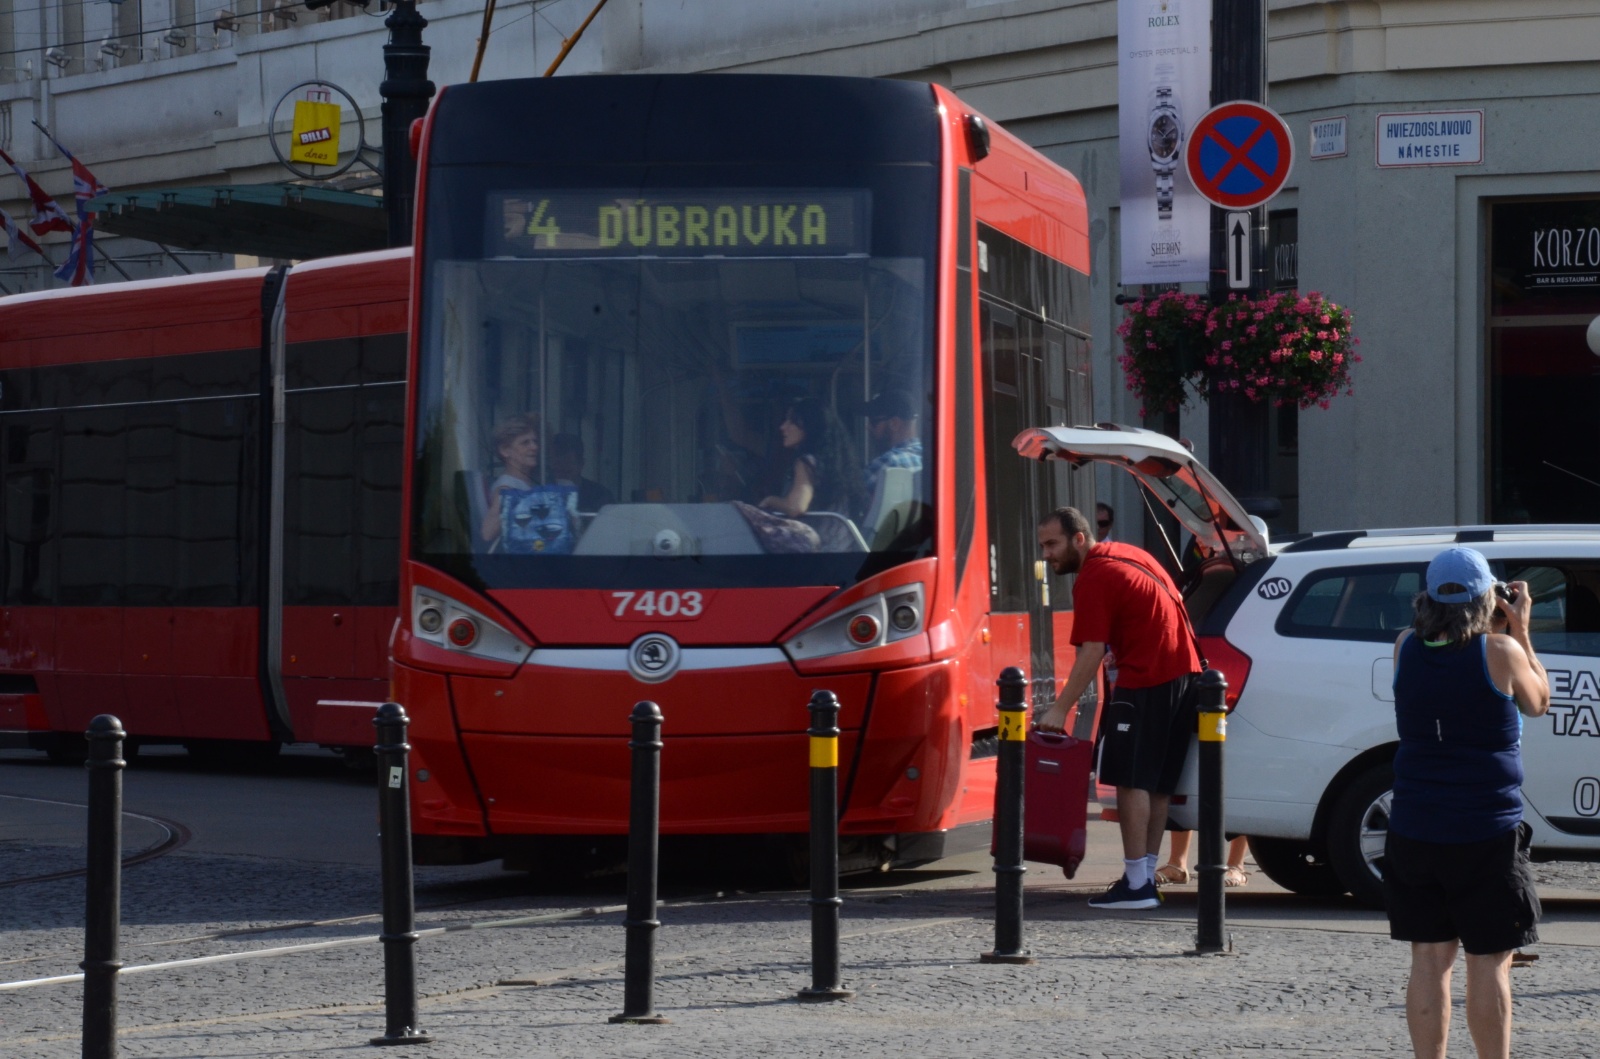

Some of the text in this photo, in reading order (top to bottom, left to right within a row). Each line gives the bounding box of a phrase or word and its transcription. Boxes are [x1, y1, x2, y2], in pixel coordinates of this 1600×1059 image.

[1148, 15, 1180, 28] ROLEX
[1129, 50, 1153, 59] OYSTER
[1155, 47, 1190, 56] PERPETUAL
[301, 129, 330, 144] BILLA
[1387, 120, 1472, 139] HVIEZDOSLAVOVO
[304, 148, 328, 160] dnes
[1398, 143, 1460, 159] NÁMESTIE
[528, 199, 827, 247] 4 DÚBRAVKA
[1534, 227, 1600, 267] KORZO
[1556, 276, 1598, 284] RESTAURANT
[1260, 579, 1290, 598] 100
[612, 591, 703, 617] 7403
